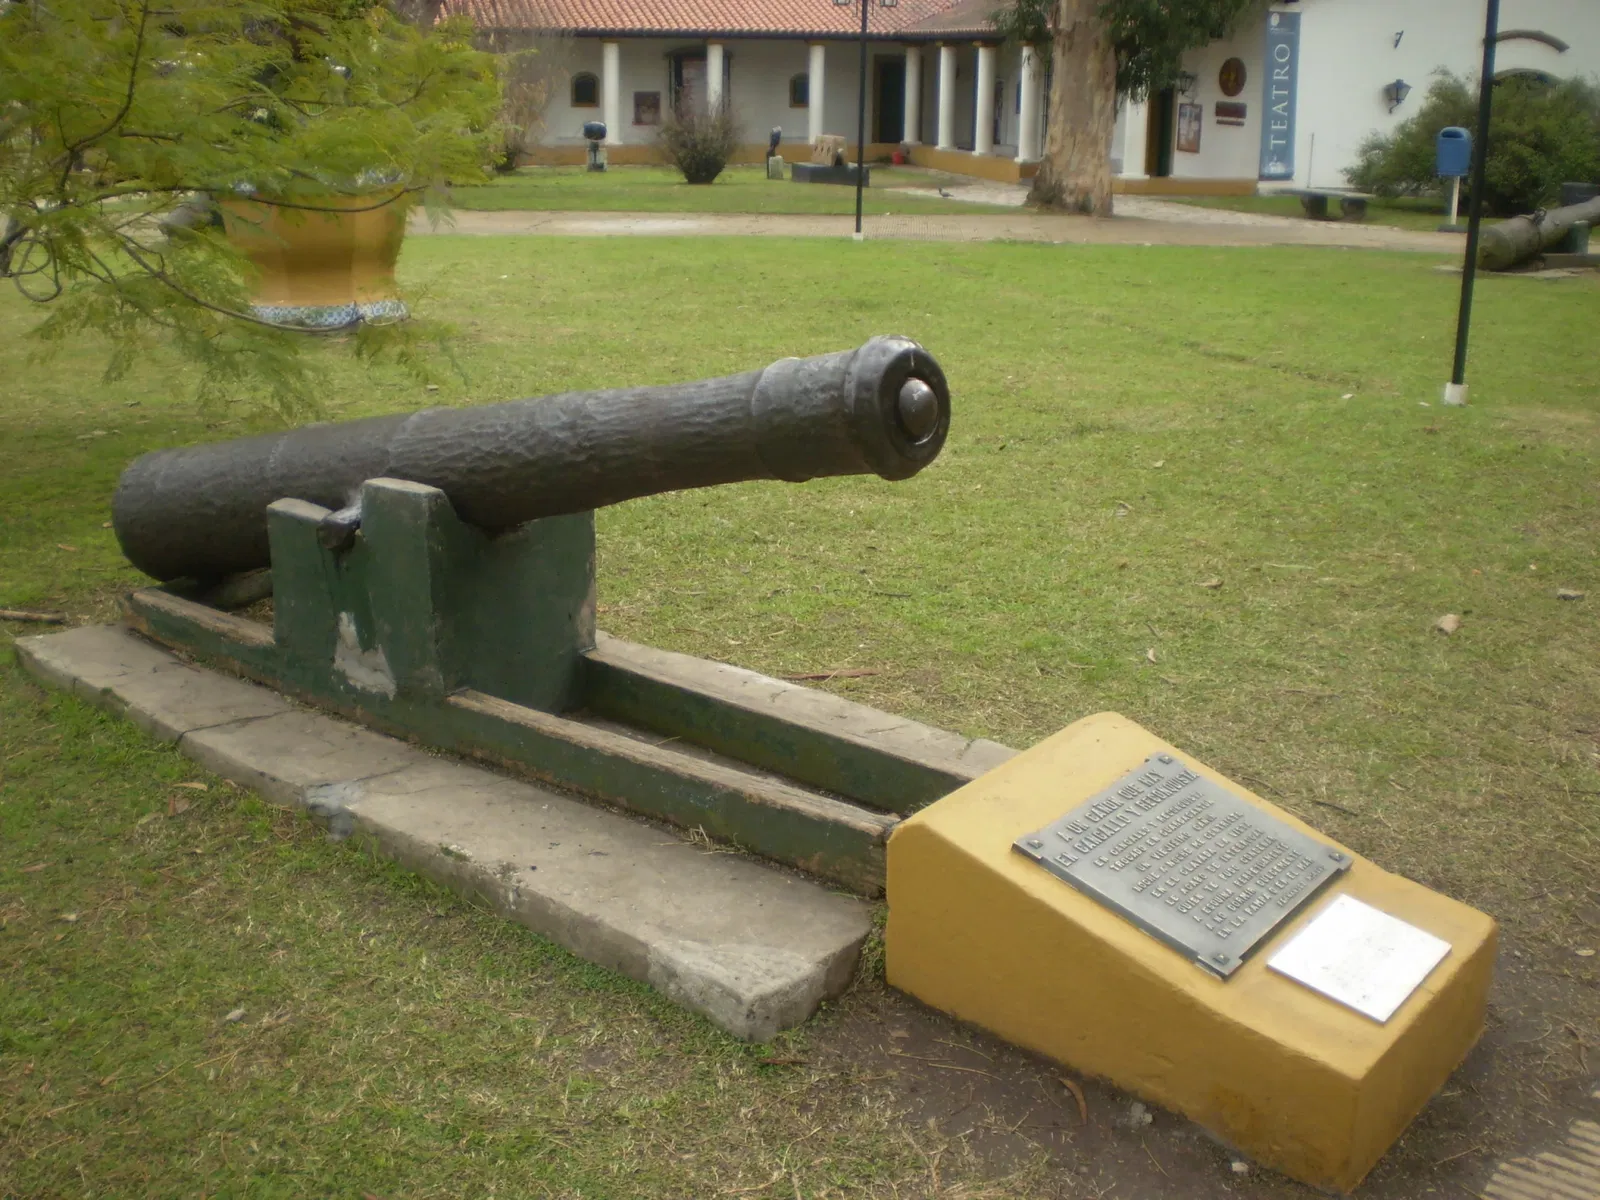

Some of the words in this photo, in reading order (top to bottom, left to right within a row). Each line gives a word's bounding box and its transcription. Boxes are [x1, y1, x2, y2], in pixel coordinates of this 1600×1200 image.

[1270, 43, 1291, 149] TEATRO
[1063, 818, 1089, 834] UN
[1081, 795, 1125, 822] CAÑON
[1116, 782, 1144, 799] QUE
[1136, 767, 1167, 786] HAY
[1134, 767, 1200, 811] RECONQUISTA
[1125, 806, 1144, 817] Y
[1072, 813, 1133, 853] CANGALLO
[1054, 850, 1079, 866] EN
[1108, 844, 1149, 872] TROCADO
[1131, 871, 1161, 893] NOCHE
[1149, 885, 1167, 898] EN
[1164, 875, 1182, 887] EL
[1163, 894, 1181, 906] LE
[1176, 892, 1206, 914] QUIEN
[1200, 887, 1235, 915] ESQUINA
[1216, 926, 1234, 939] EN
[1229, 914, 1247, 928] LA
[1242, 892, 1273, 916] PAMPA
